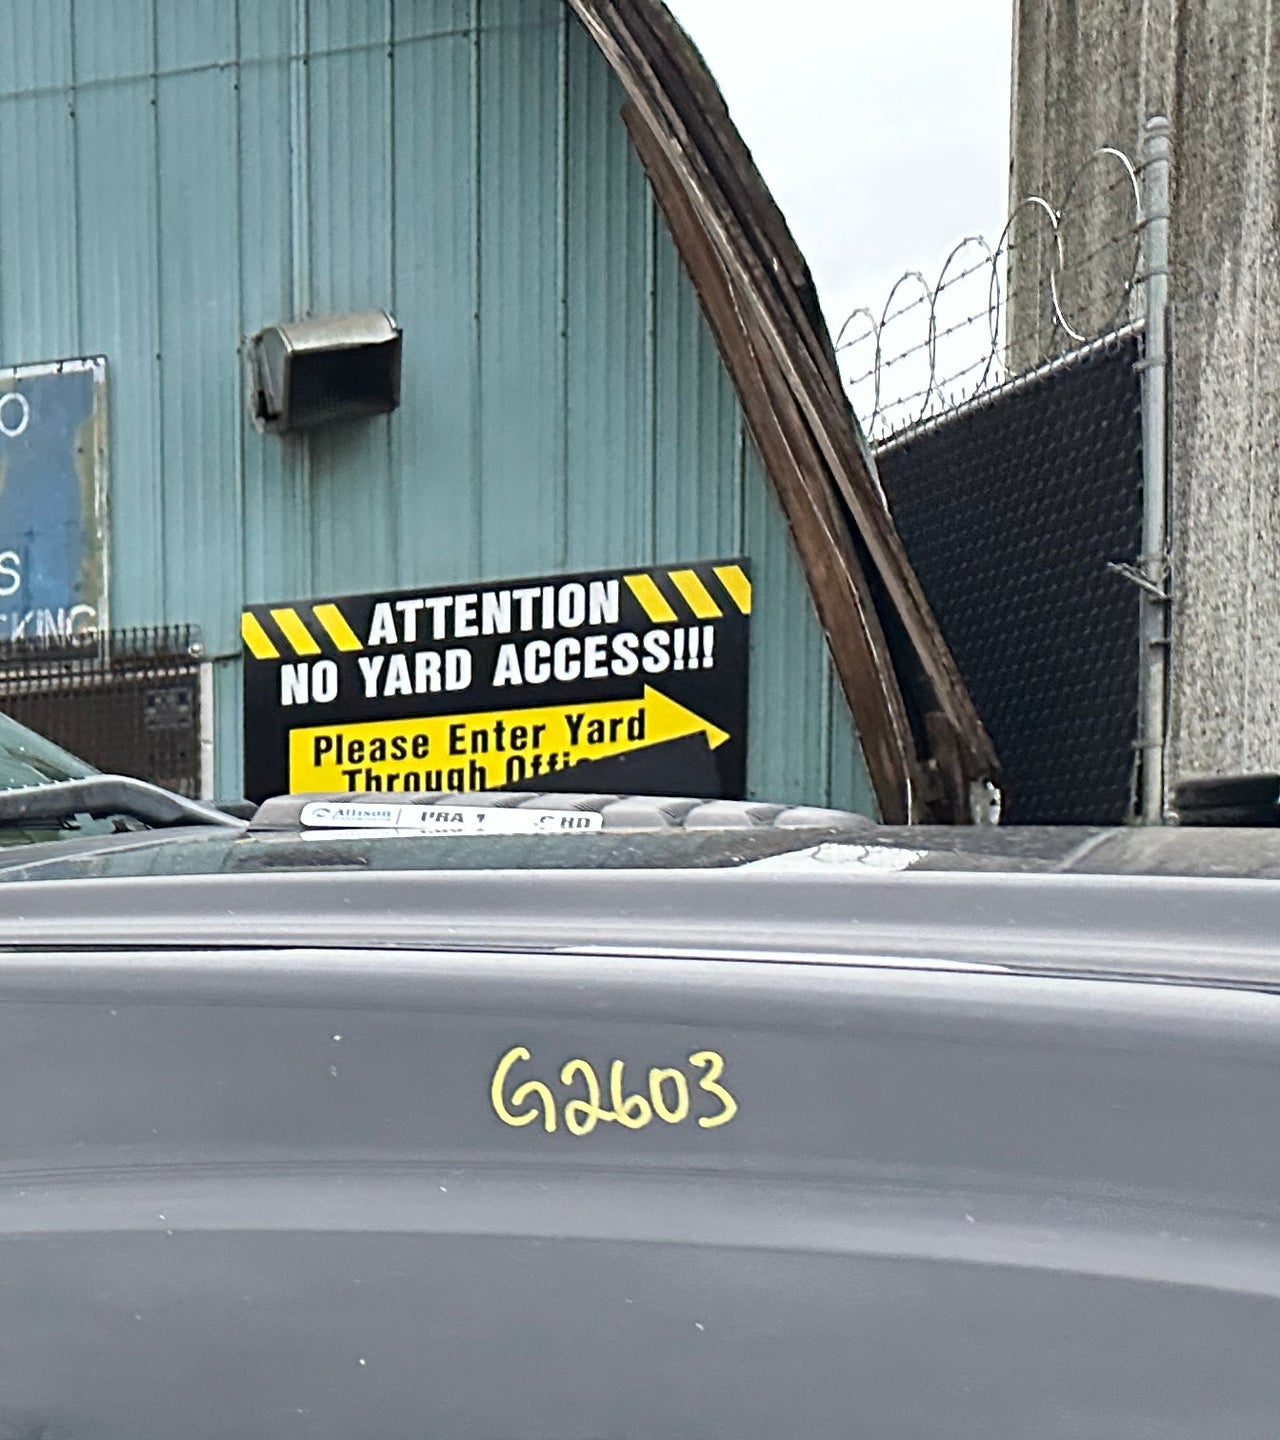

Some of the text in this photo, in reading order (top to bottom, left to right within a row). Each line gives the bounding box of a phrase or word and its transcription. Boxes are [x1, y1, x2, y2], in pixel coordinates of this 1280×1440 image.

[367, 579, 620, 647] ATTENTION
[280, 625, 716, 706] NO YARD ACCESS!!!
[313, 708, 646, 767] Please Enter Yard
[342, 760, 487, 792] Through
[490, 1046, 738, 1136] G2603
